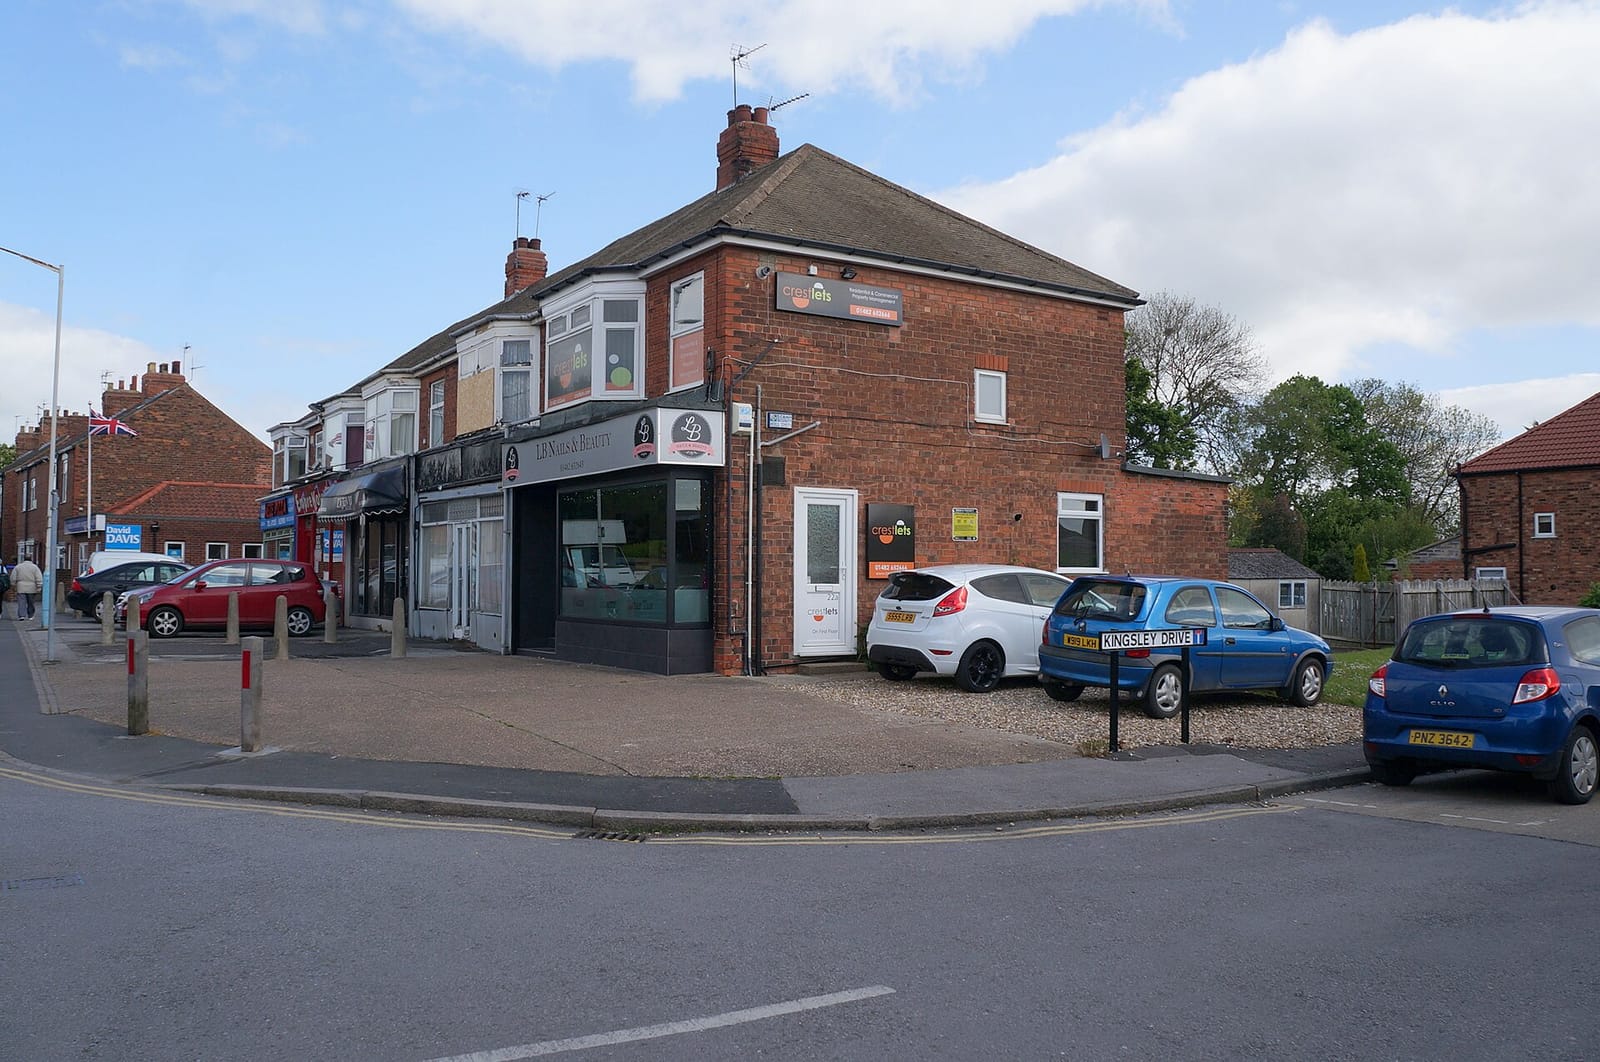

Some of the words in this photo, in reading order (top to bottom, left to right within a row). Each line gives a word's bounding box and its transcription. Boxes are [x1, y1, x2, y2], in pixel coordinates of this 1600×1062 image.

[782, 286, 832, 302] crestlets
[852, 293, 869, 301] Property
[869, 296, 896, 304] Management
[106, 526, 131, 534] David
[871, 525, 912, 536] crestlets
[106, 534, 140, 544] DAVIS
[1081, 638, 1097, 649] LKH
[1103, 633, 1157, 648] KINGSLEY
[1161, 631, 1191, 645] DRIVE
[1413, 732, 1436, 744] PNZ
[1438, 733, 1469, 747] 3642
